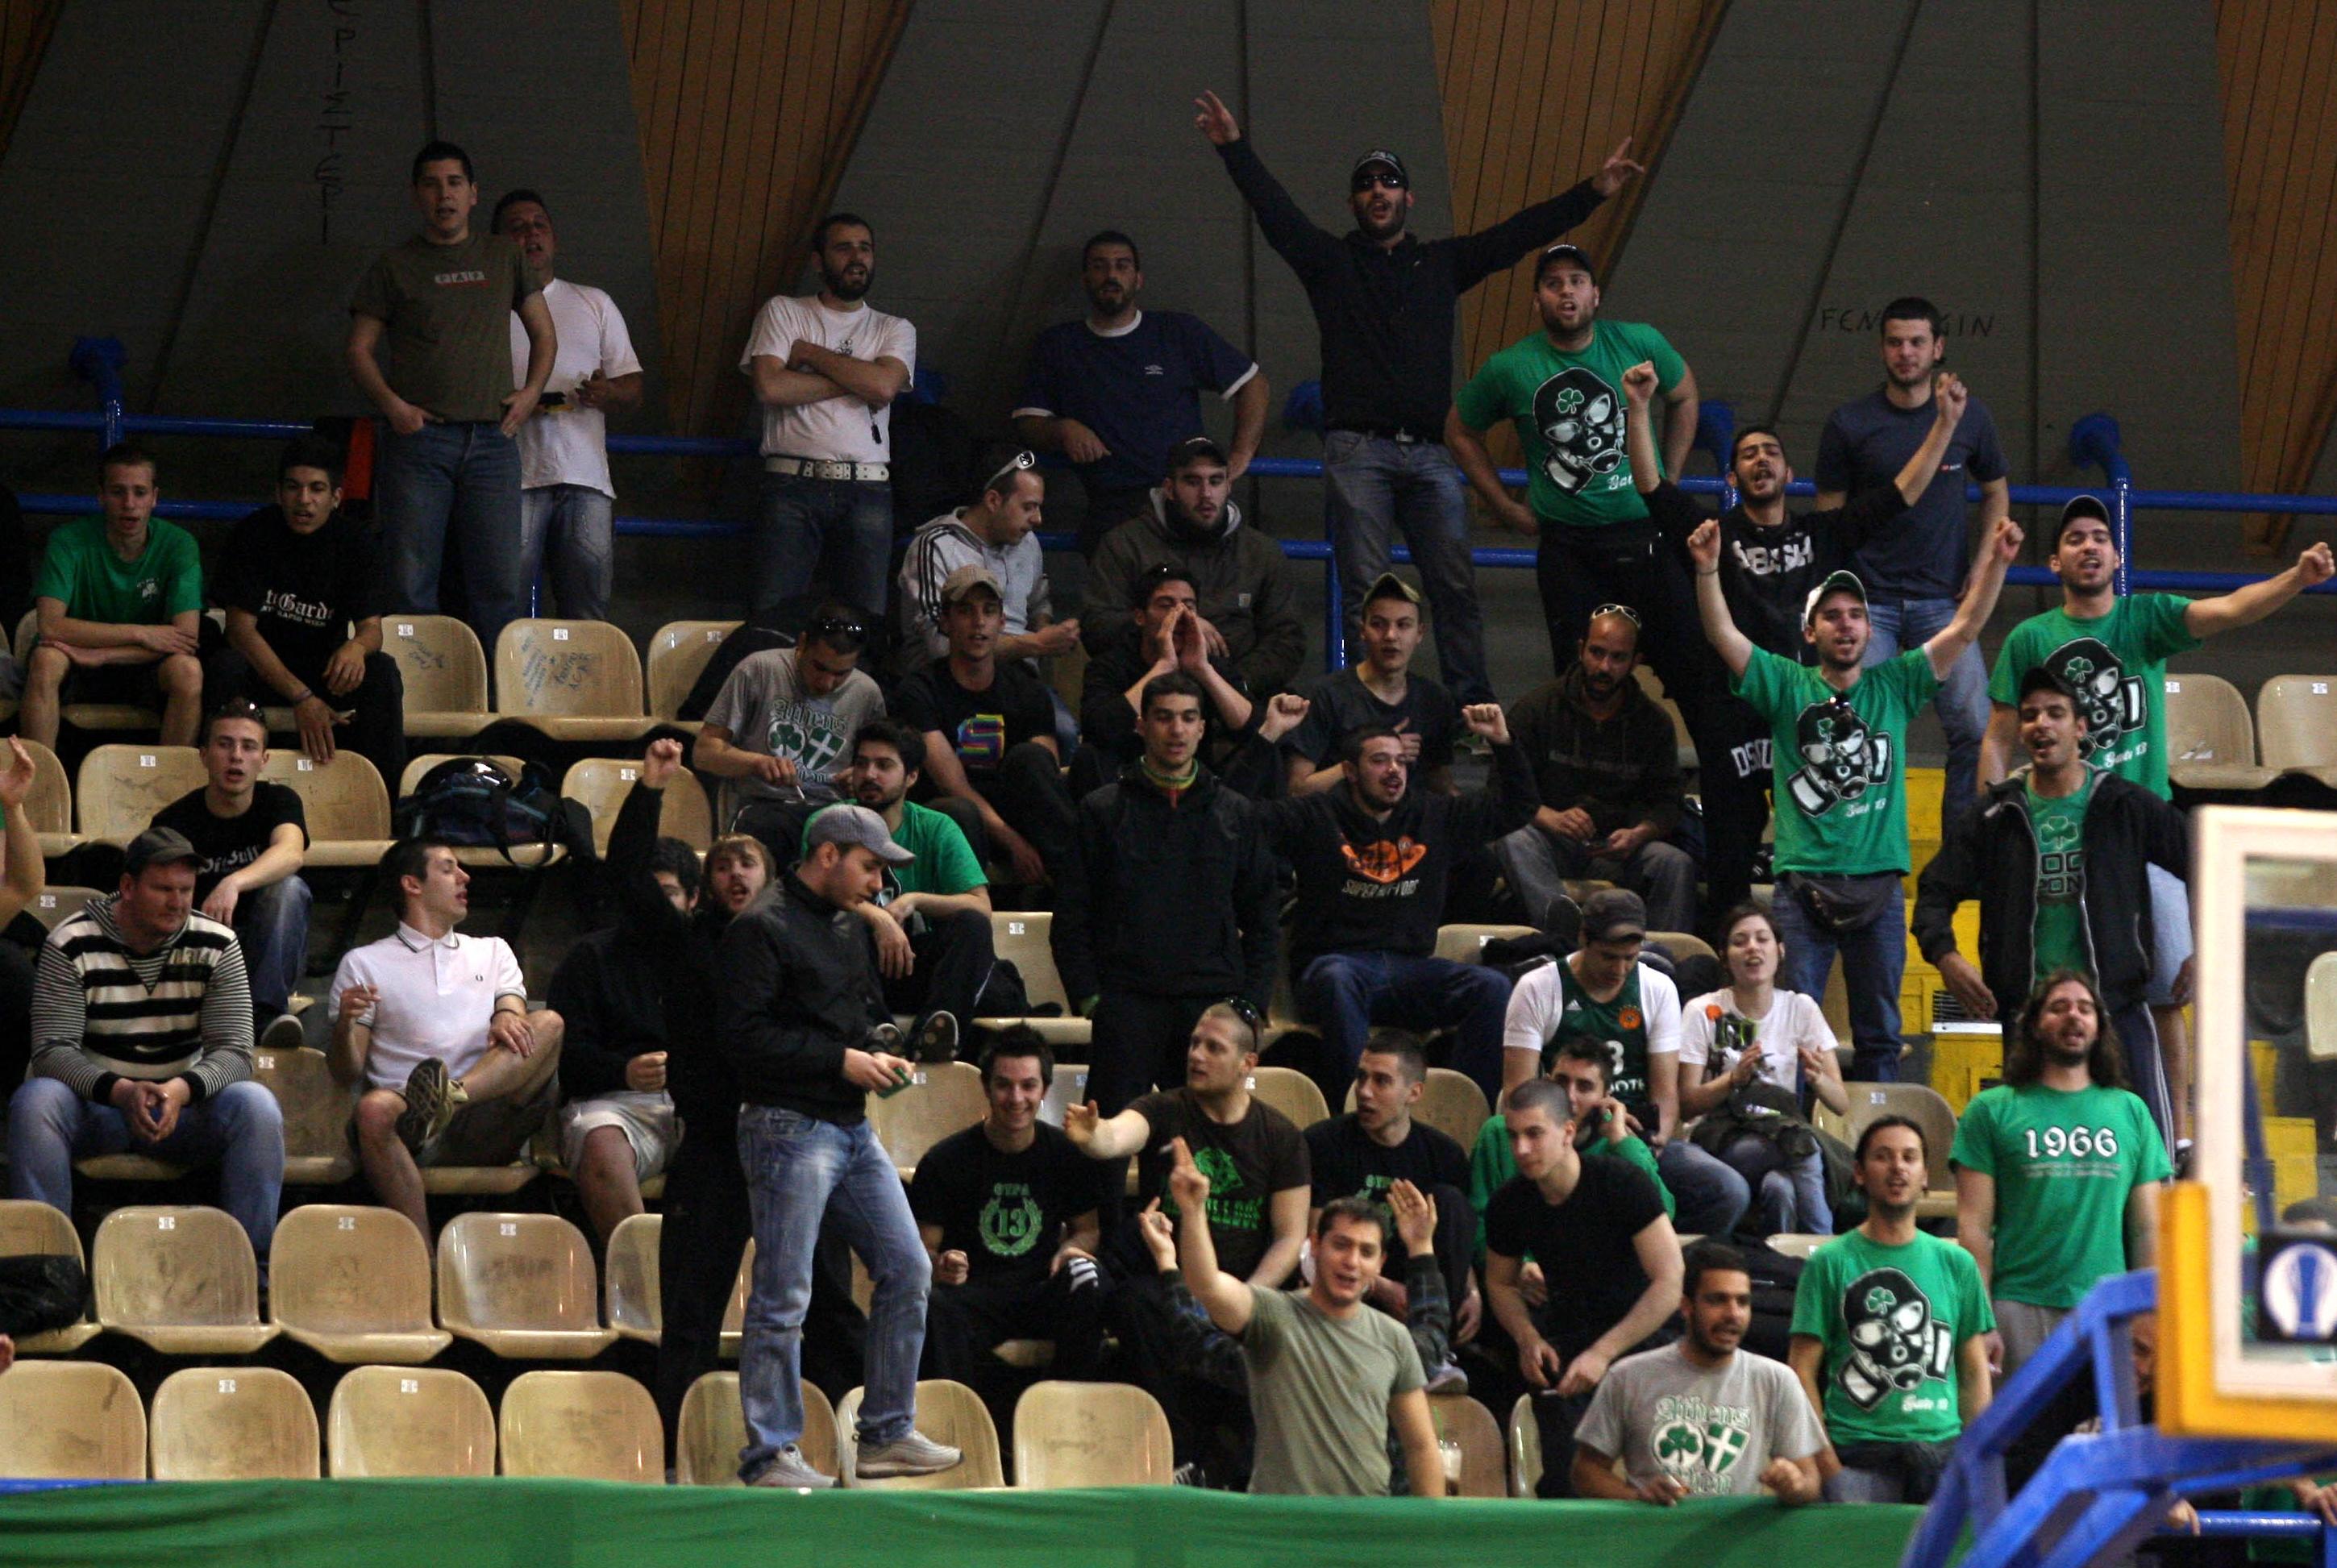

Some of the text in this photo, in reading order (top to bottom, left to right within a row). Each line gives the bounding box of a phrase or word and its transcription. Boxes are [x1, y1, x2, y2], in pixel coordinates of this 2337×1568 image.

[1607, 474, 1634, 490] Gat
[2025, 1125, 2119, 1158] 1966
[996, 1208, 1028, 1237] 13
